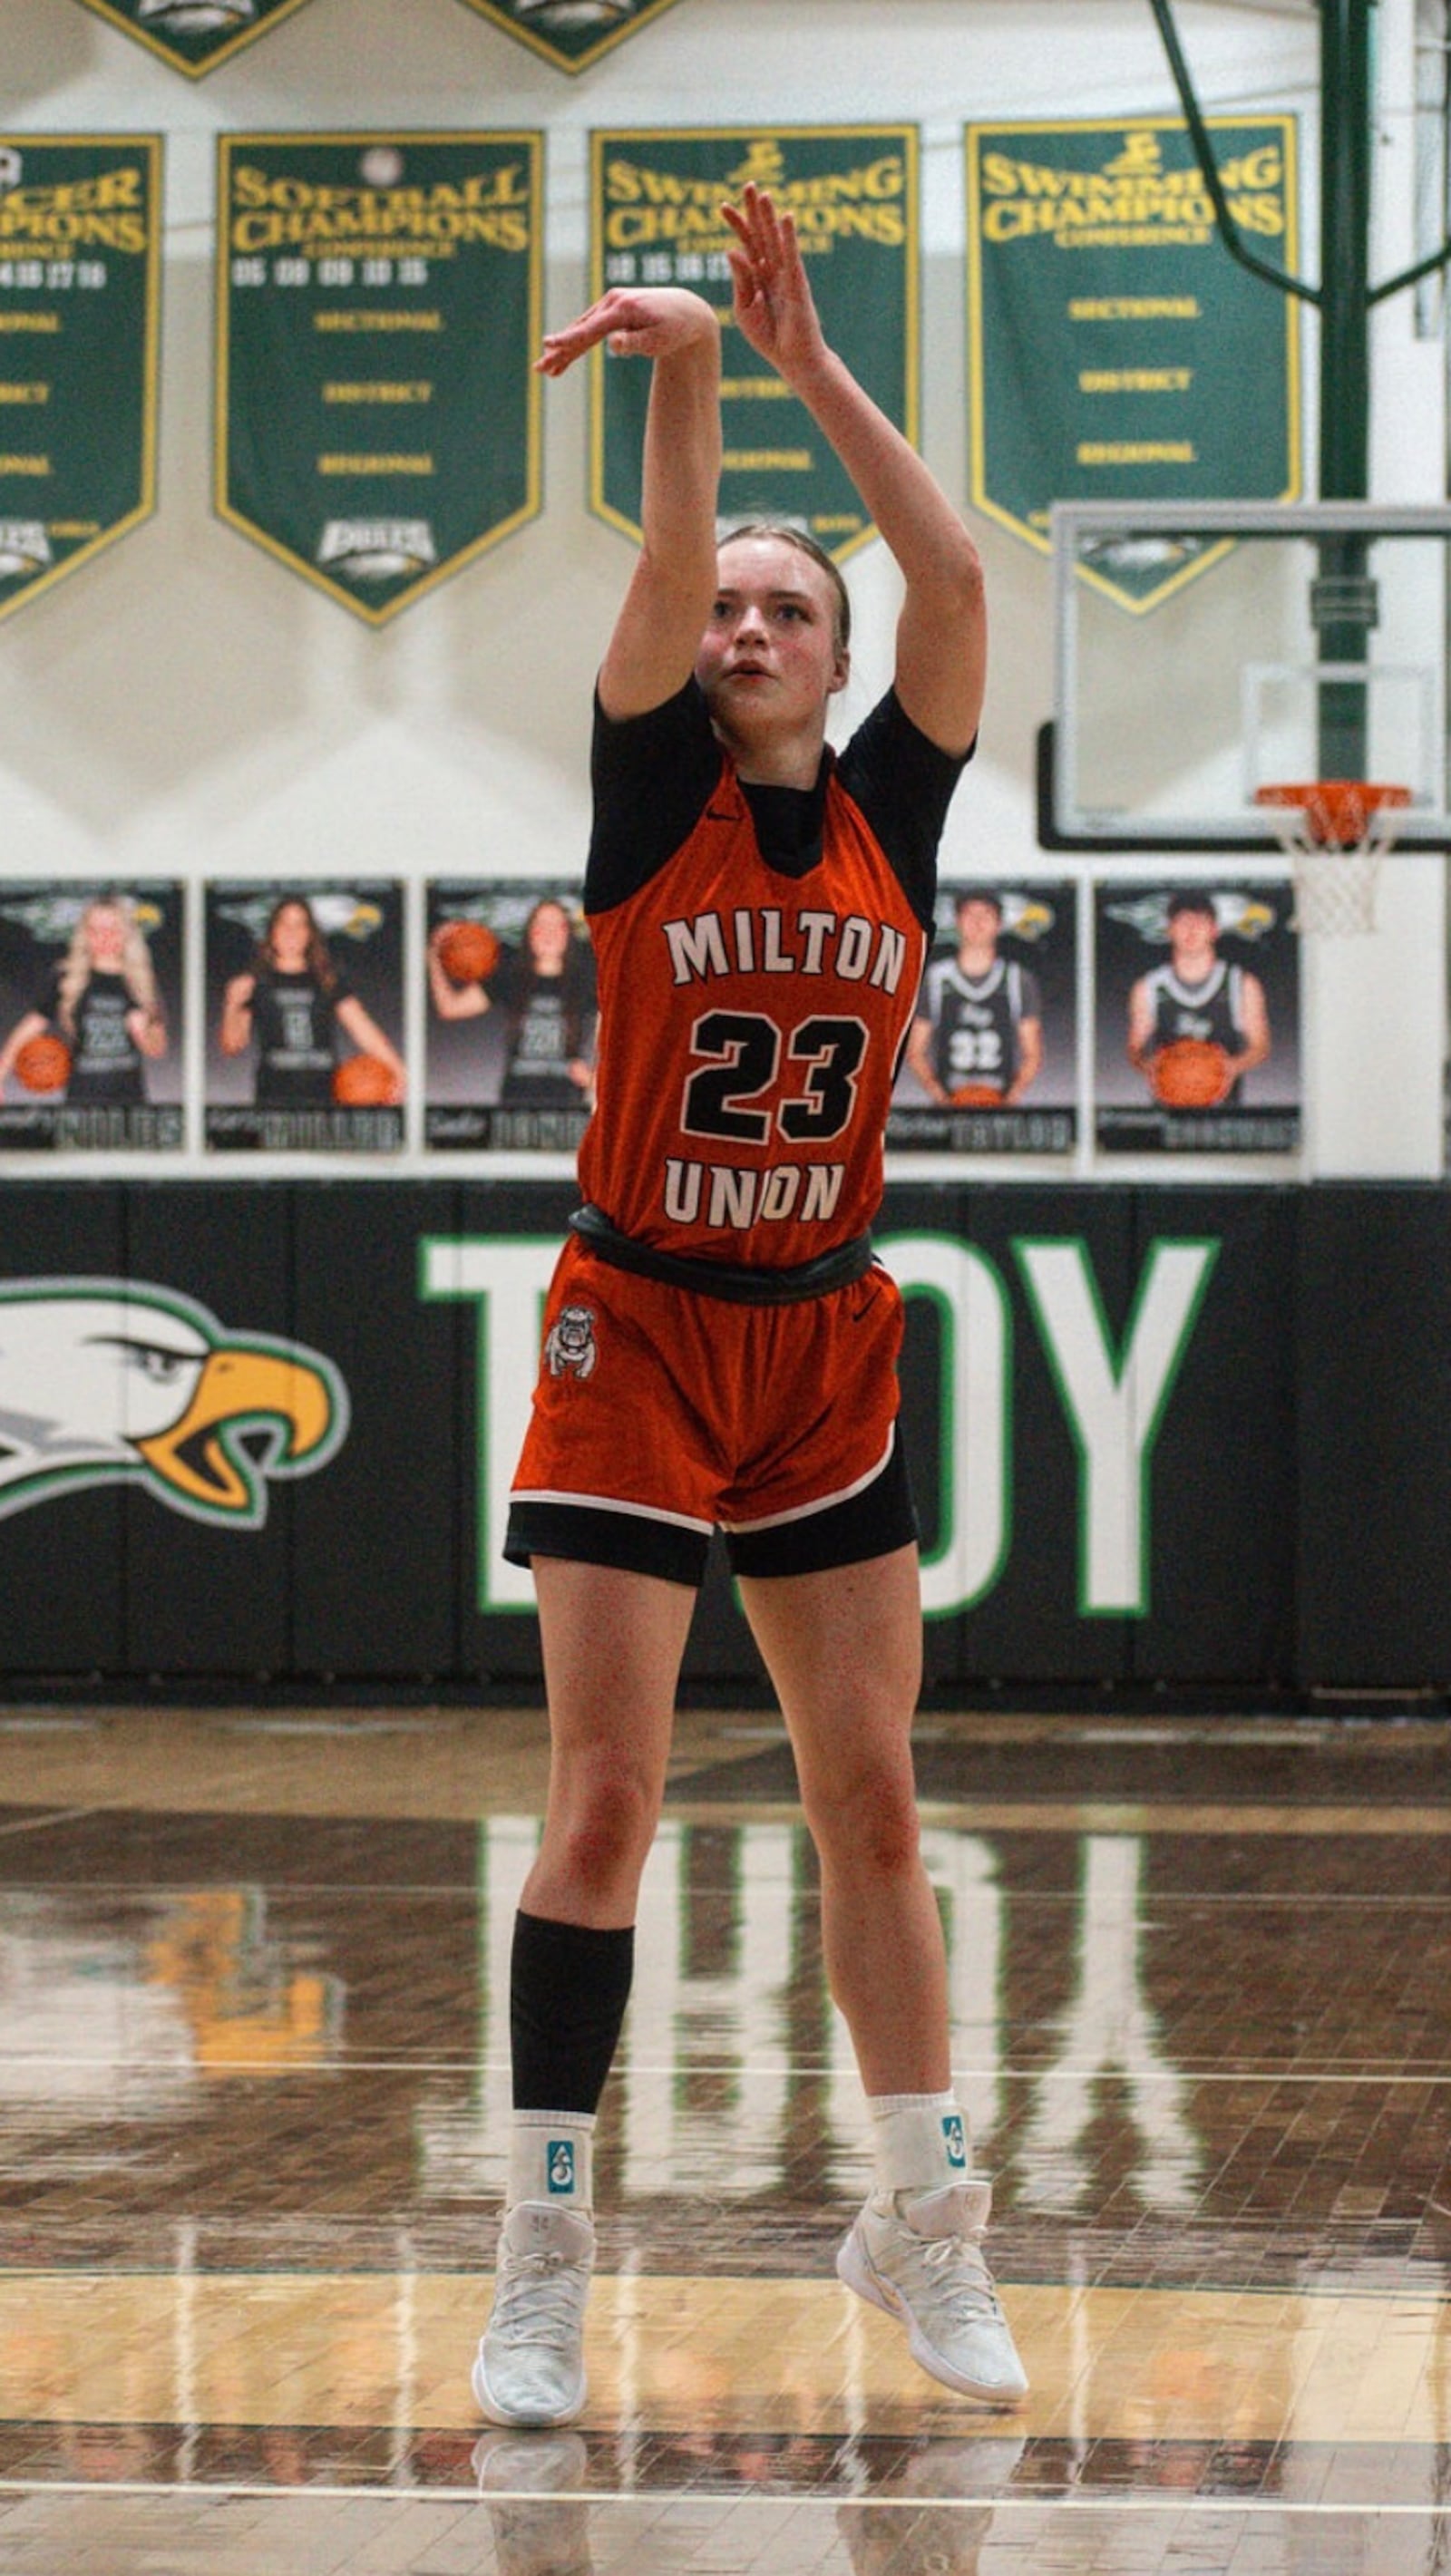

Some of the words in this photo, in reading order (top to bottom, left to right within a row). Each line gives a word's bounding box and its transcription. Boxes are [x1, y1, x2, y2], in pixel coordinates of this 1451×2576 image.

[233, 165, 528, 209] SOFTBALL
[233, 210, 529, 253] CHAMPIONS
[662, 908, 907, 996] MILTON
[680, 1008, 870, 1145] 23
[665, 1158, 845, 1229] UNON
